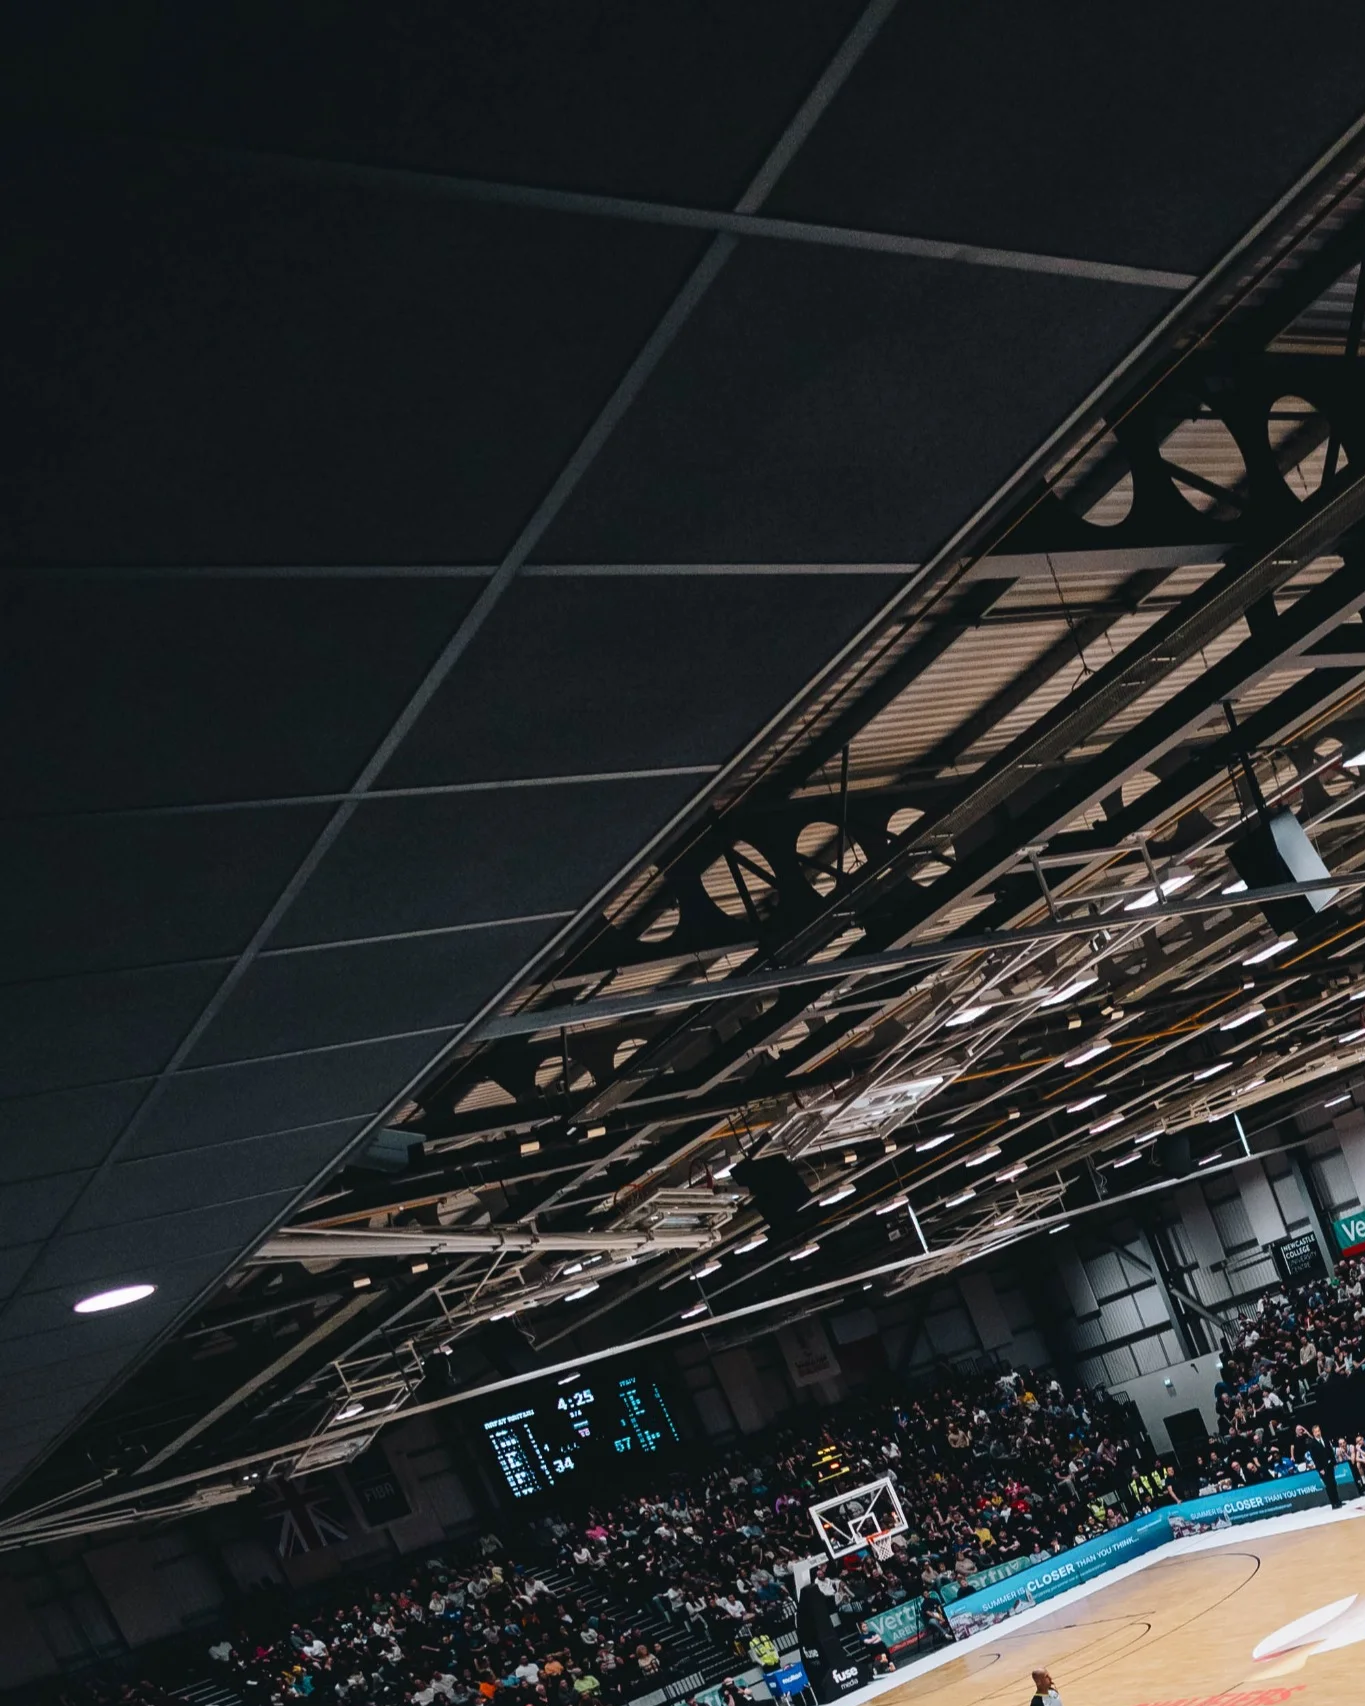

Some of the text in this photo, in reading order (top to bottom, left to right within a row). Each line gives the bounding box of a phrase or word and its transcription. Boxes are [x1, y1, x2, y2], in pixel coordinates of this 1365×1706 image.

[1283, 1233, 1316, 1251] NEWCASTLE
[1285, 1244, 1311, 1260] COLLEGE
[557, 1388, 594, 1411] 4:25
[553, 1456, 575, 1474] 34
[1190, 1509, 1217, 1521] SUMMER
[1224, 1496, 1264, 1514] CLOSER
[1264, 1494, 1283, 1505] THAN
[1283, 1490, 1297, 1500] YOU
[981, 1590, 1018, 1612] SUMMER
[1017, 1586, 1026, 1597] IS
[1027, 1562, 1076, 1592] CLOSER
[1075, 1555, 1097, 1569] THAN
[1096, 1548, 1112, 1560] YOU
[832, 1664, 859, 1685] fuse
[841, 1677, 860, 1690] media
